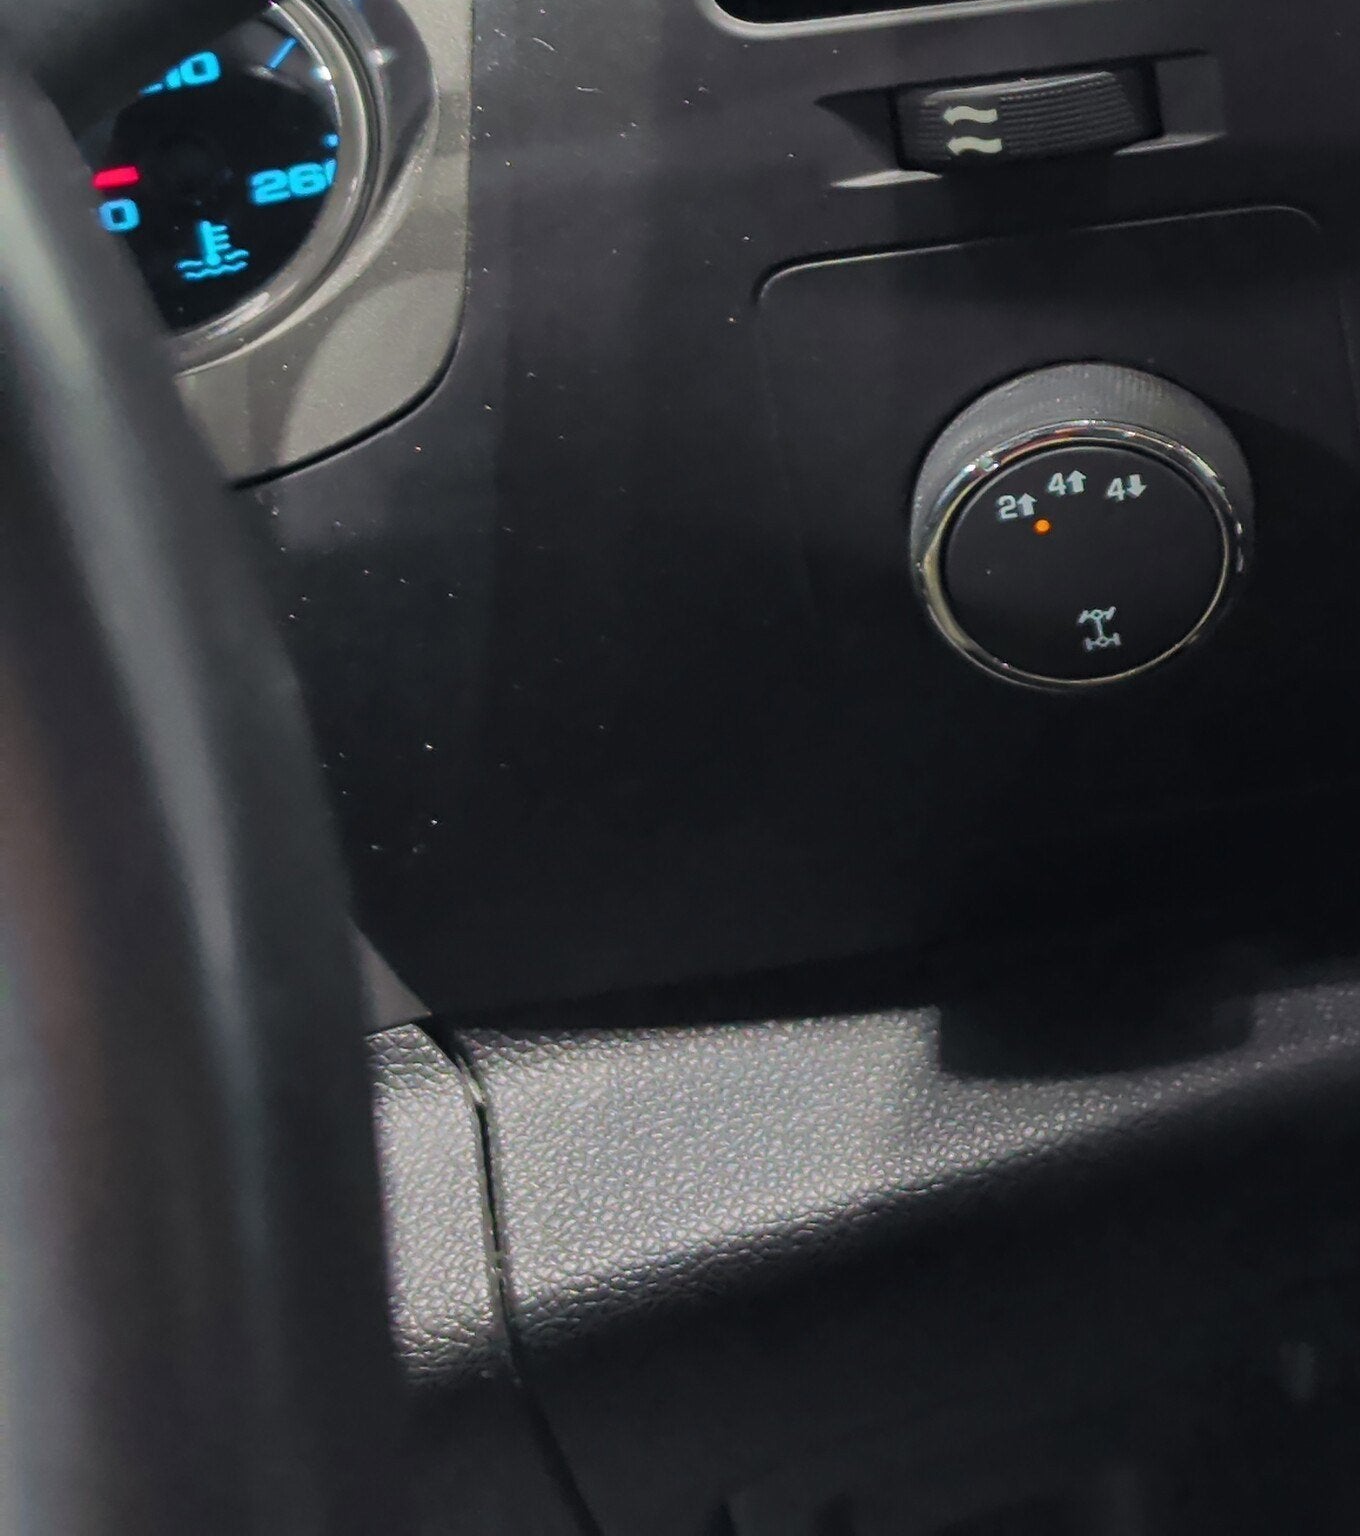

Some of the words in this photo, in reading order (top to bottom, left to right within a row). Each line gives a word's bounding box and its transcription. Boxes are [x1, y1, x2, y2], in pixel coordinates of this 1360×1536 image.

[1049, 473, 1067, 497] 4
[1106, 478, 1126, 502] 4
[997, 495, 1018, 520] 2
